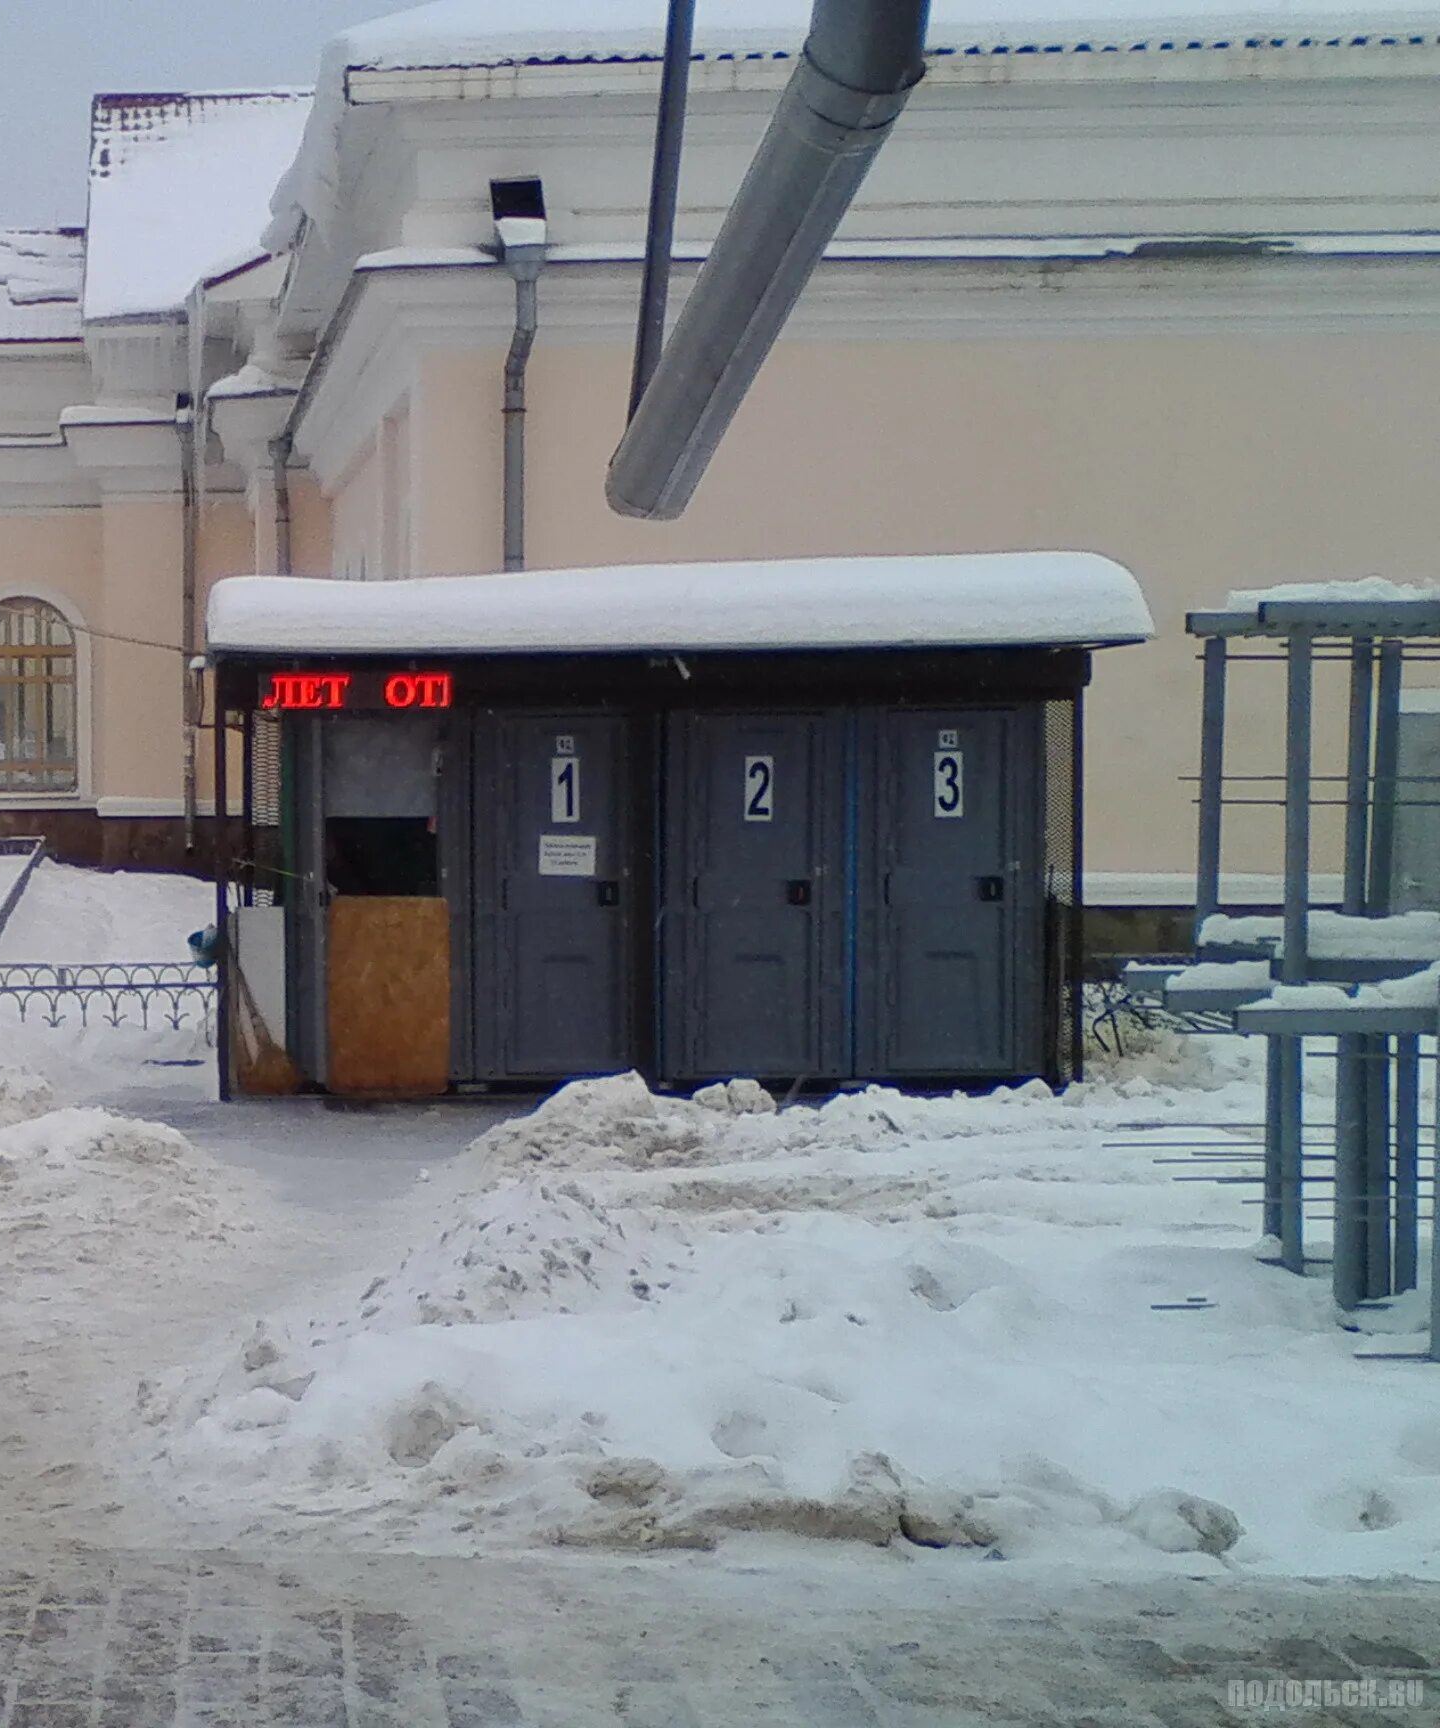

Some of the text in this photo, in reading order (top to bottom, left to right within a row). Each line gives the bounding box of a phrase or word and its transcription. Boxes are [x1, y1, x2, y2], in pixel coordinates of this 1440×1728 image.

[262, 674, 449, 708] ЛЕТ ОТ
[558, 762, 573, 817] 1
[748, 761, 770, 816] 2
[938, 757, 960, 812] 3
